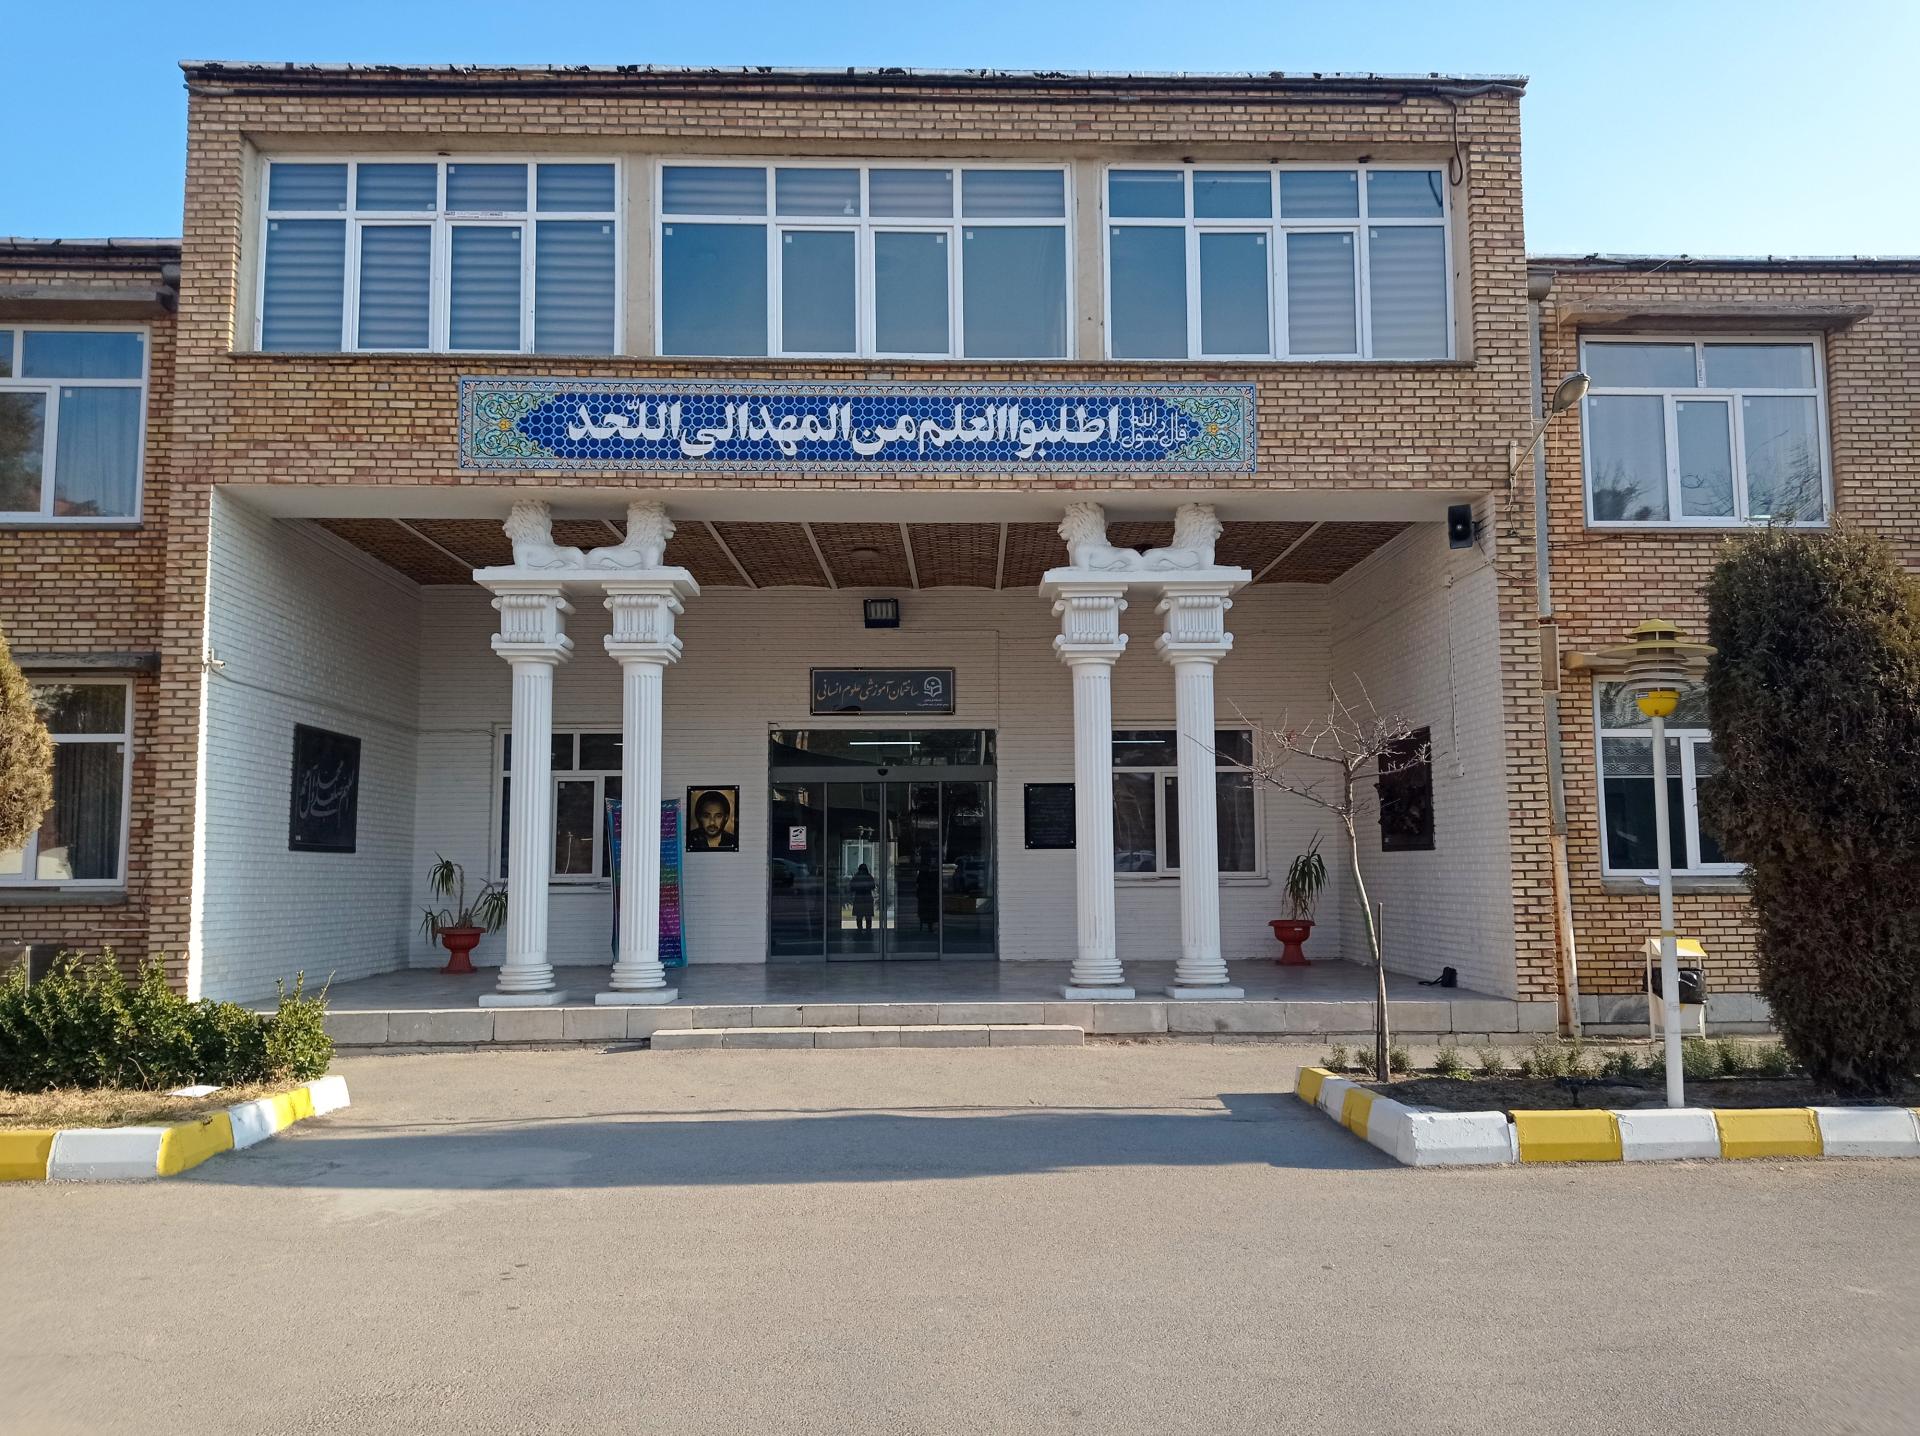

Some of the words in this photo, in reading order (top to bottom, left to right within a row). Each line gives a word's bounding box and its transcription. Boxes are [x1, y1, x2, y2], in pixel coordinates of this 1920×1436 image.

[750, 402, 850, 456] المهد
[852, 414, 917, 456] من
[919, 402, 1008, 455] العلم
[1009, 402, 1119, 459] اطلبوا
[1121, 403, 1166, 449] رسول
[1160, 411, 1187, 447] قال
[816, 679, 842, 700] انسانی
[841, 683, 861, 705] علوم
[859, 678, 895, 700] آموزشی
[888, 679, 919, 700] ساختمان
